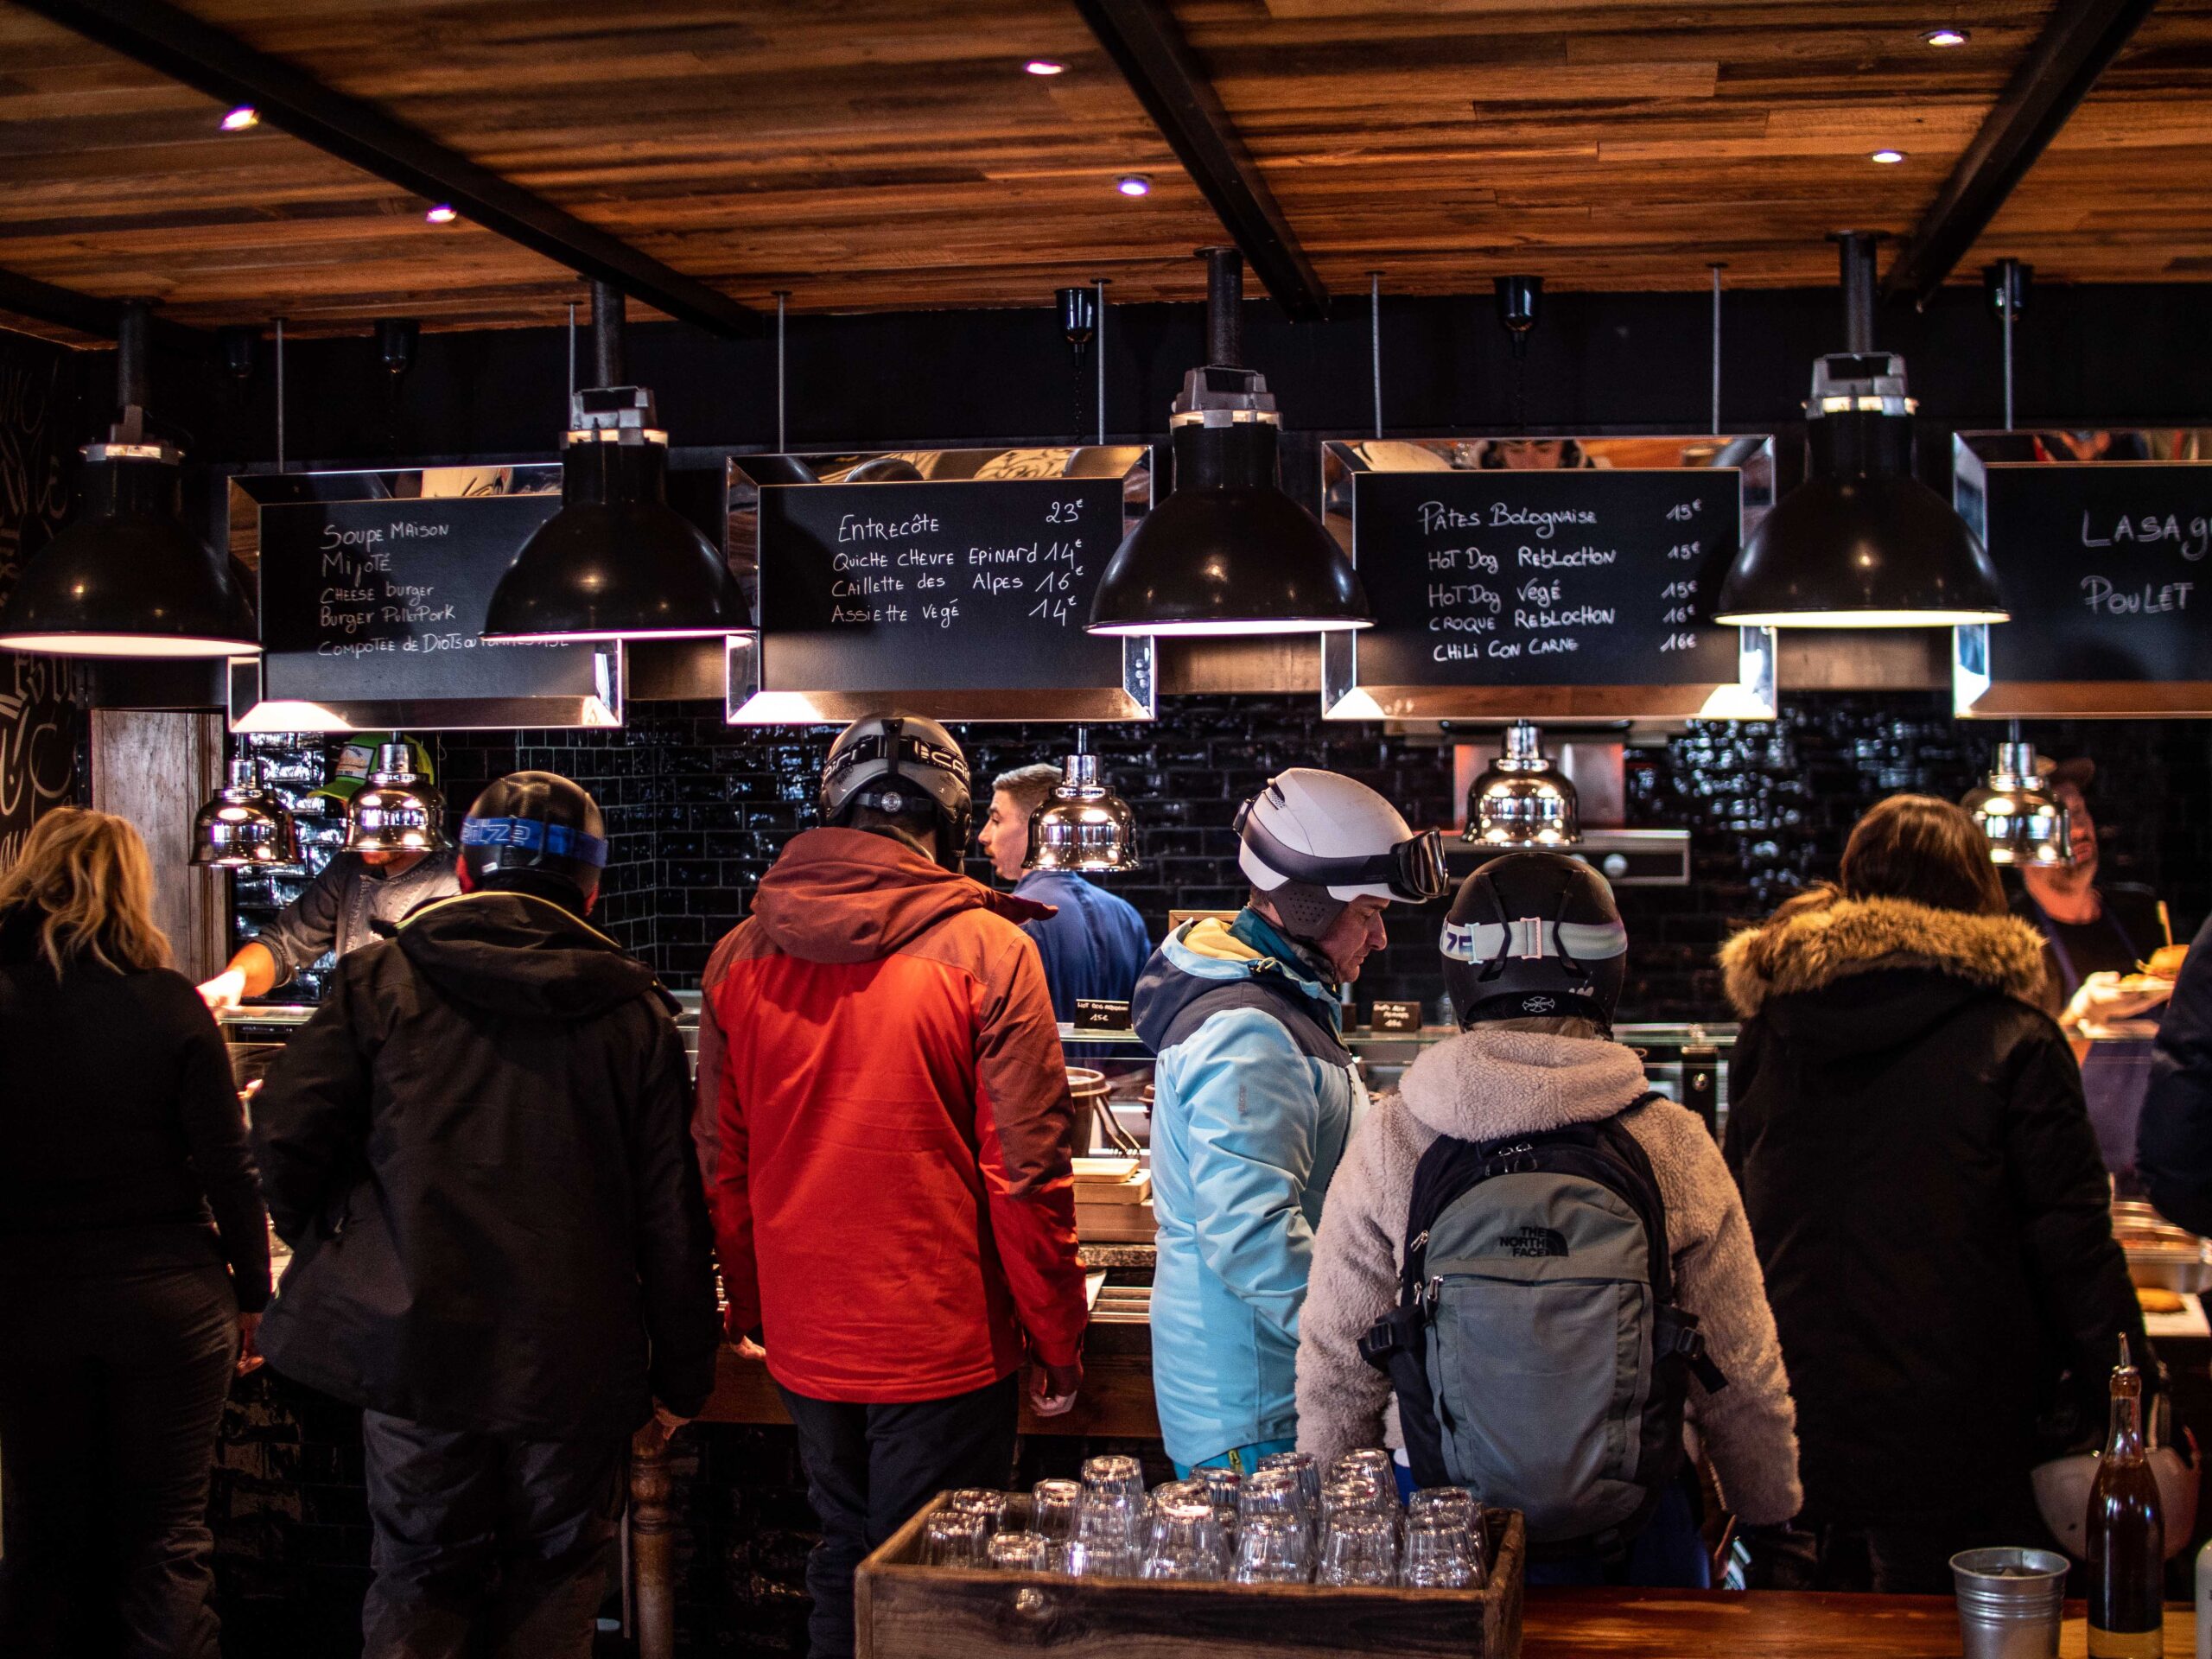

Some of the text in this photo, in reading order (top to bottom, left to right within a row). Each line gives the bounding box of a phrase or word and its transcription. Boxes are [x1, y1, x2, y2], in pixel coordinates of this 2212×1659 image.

[2082, 511, 2212, 561] LASAg
[1521, 1227, 1547, 1237] THE
[1500, 1237, 1545, 1247] NORTH
[1513, 1248, 1547, 1257] FACE
